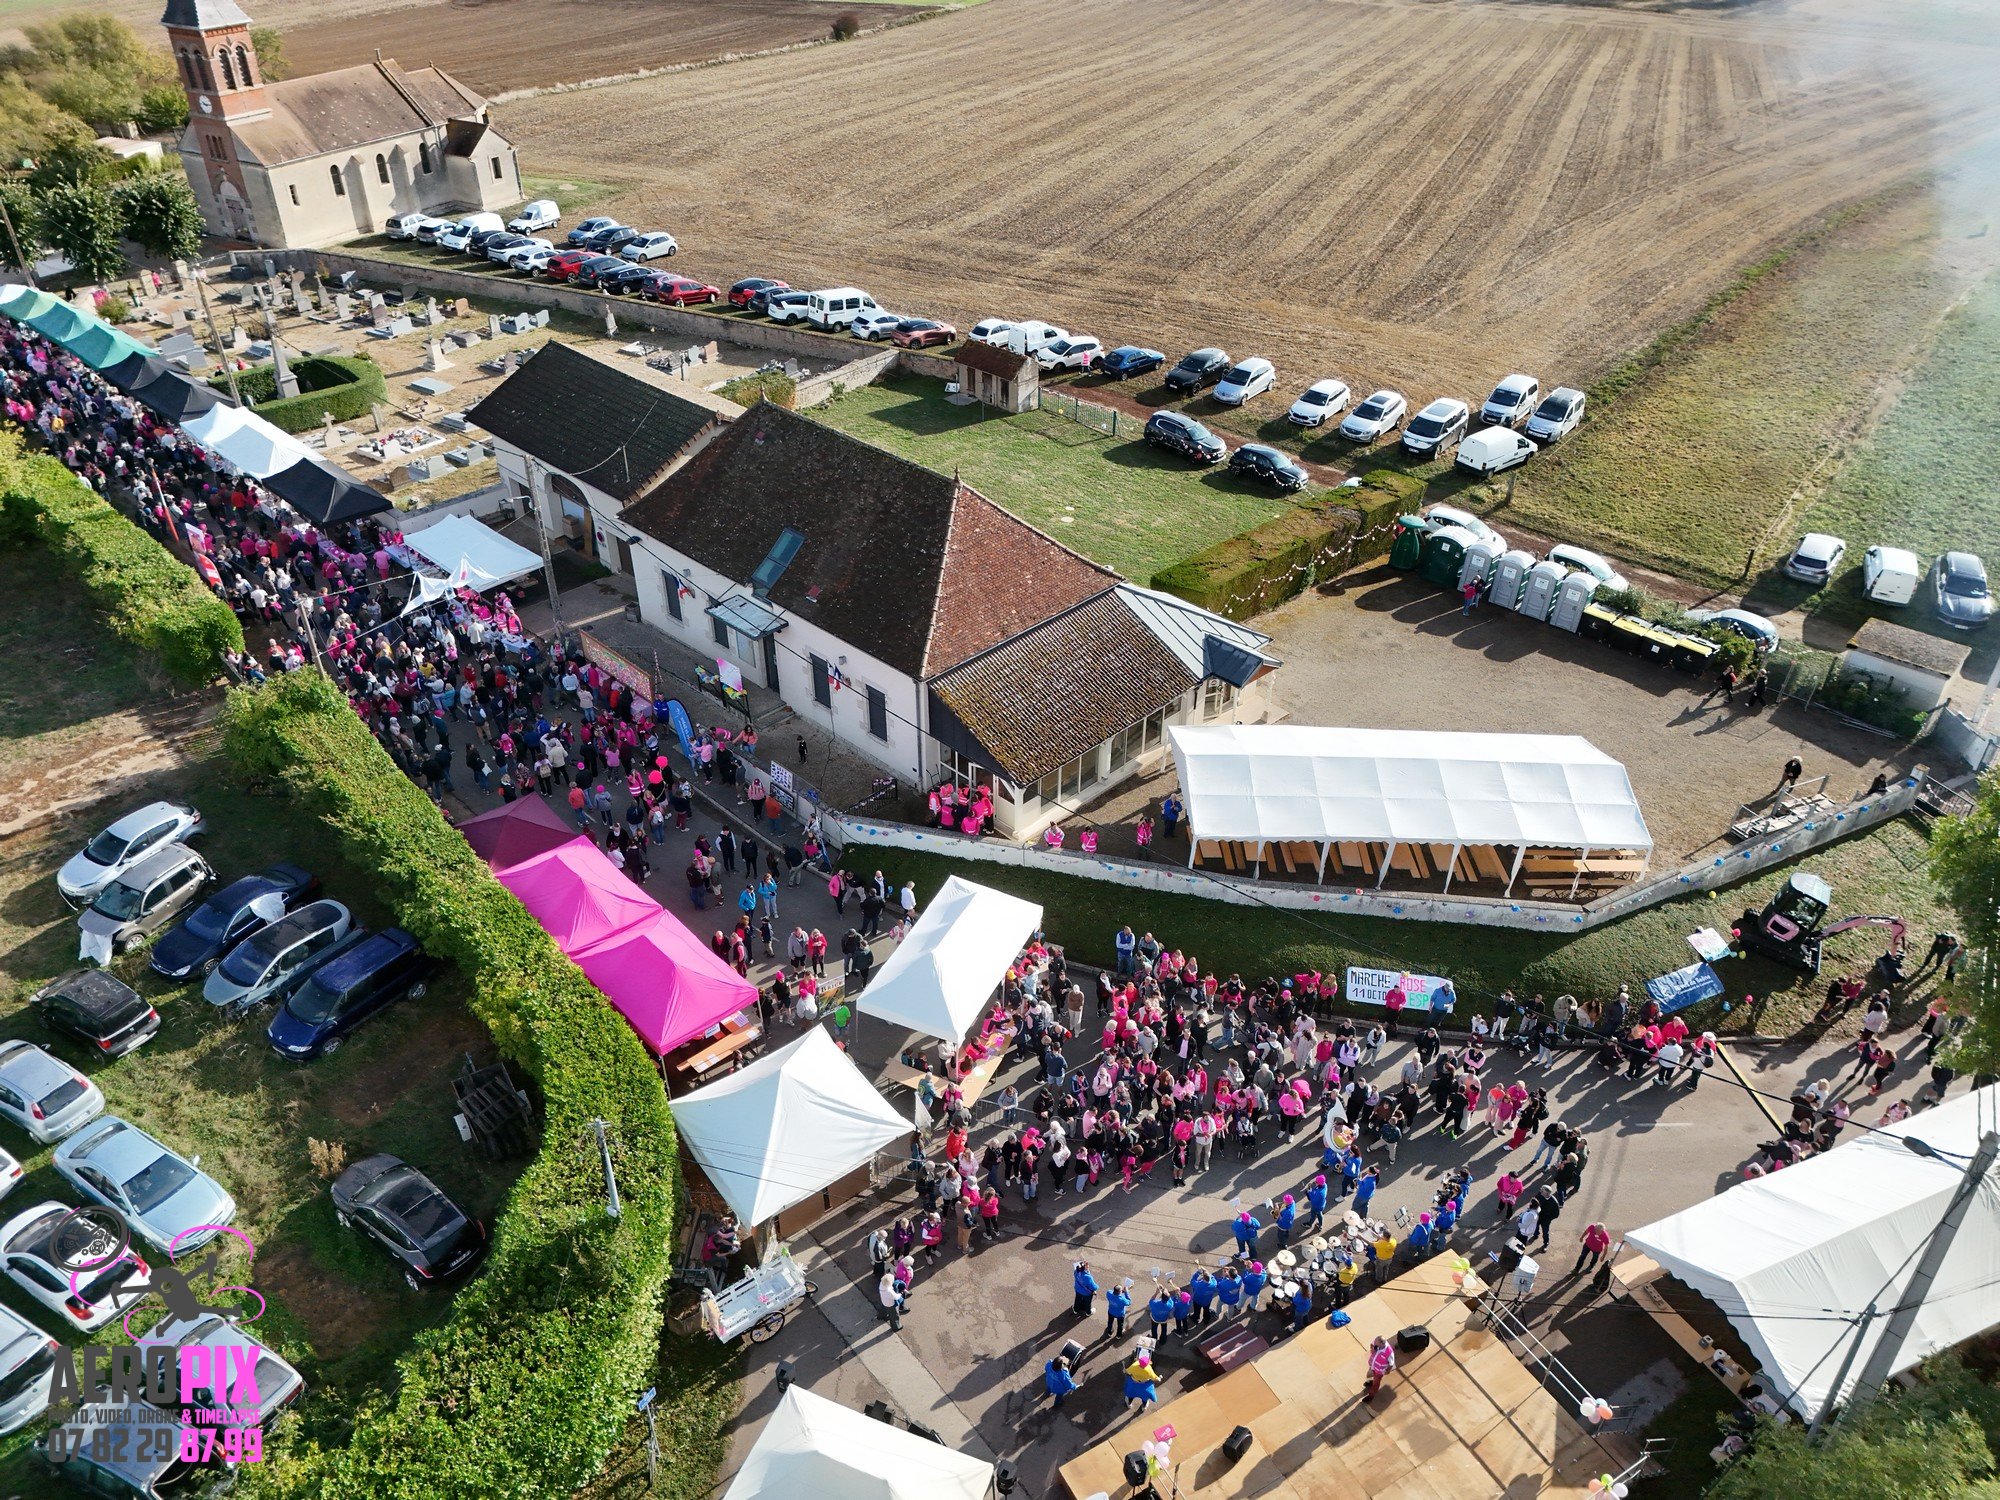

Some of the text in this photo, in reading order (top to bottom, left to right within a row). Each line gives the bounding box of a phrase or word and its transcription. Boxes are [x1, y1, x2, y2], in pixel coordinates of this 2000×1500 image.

[1350, 970, 1427, 992] MARCHE ROSE
[1352, 987, 1429, 1007] 11 OCTO ESP
